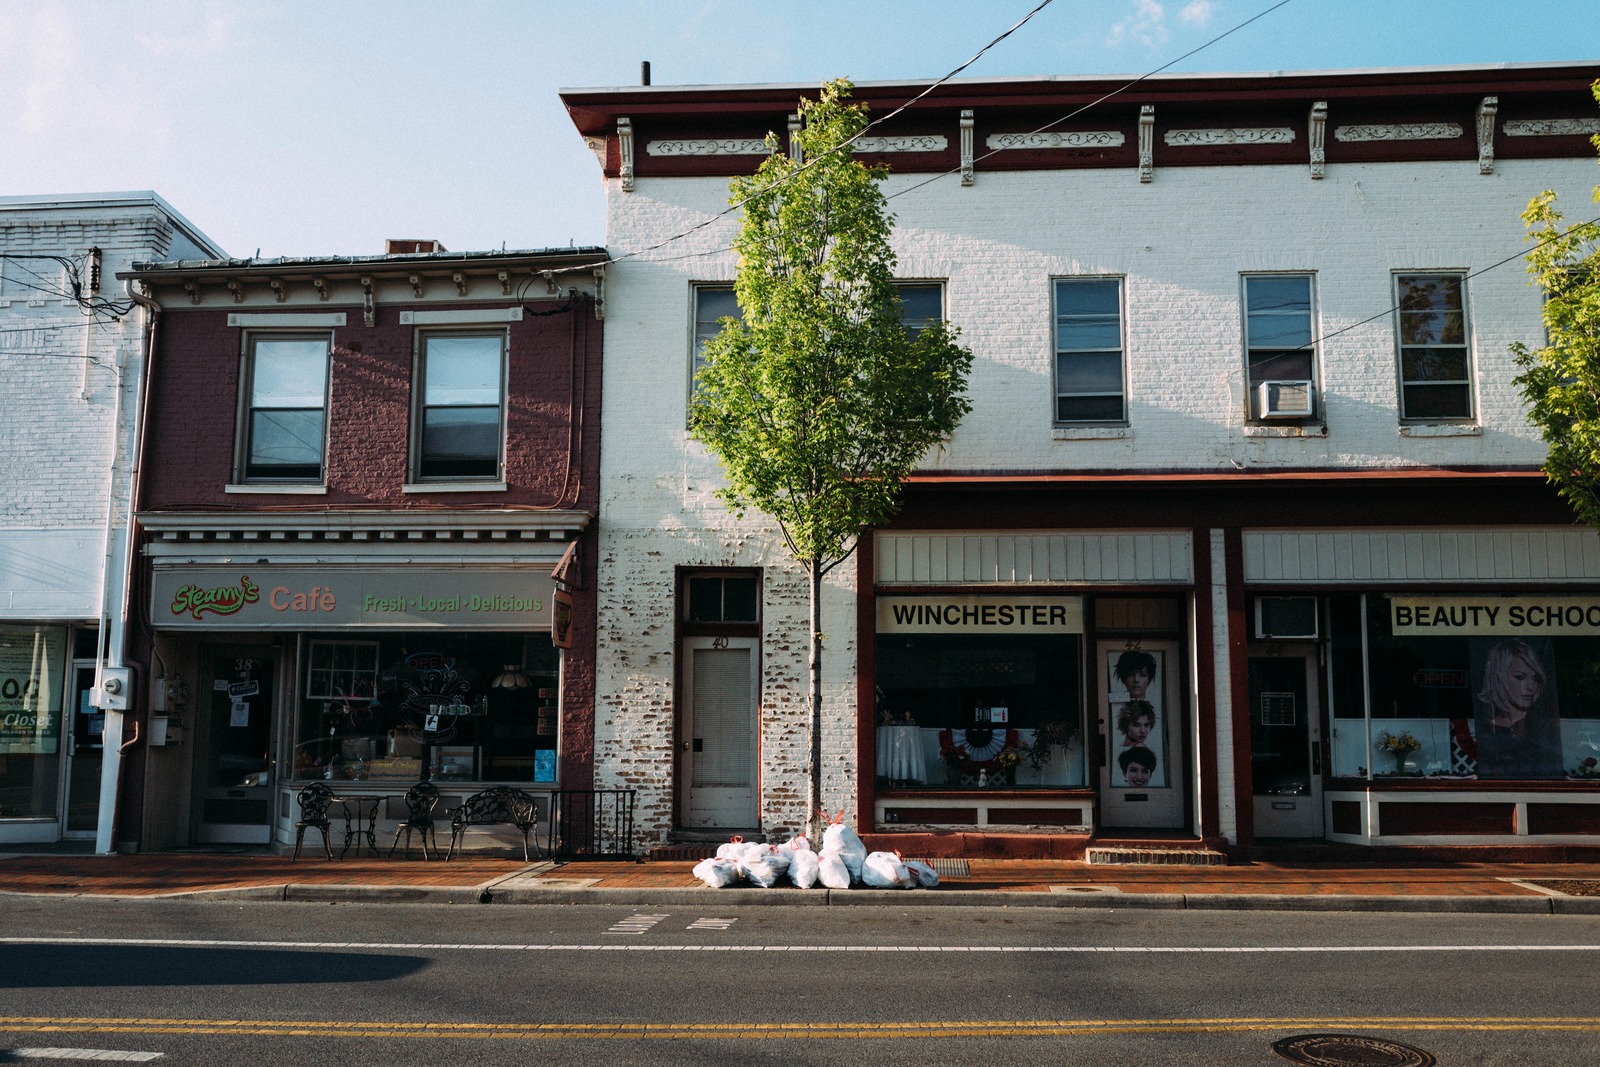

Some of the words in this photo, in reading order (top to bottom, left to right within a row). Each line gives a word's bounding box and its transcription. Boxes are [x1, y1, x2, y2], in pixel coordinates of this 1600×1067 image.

[171, 577, 259, 620] Steamy's
[364, 594, 408, 612] Fresh
[418, 595, 461, 612] Local
[470, 594, 543, 612] Delicious
[892, 604, 1067, 626] WINCHESTER
[1395, 606, 1500, 627] BEAUTY
[712, 632, 729, 649] 40
[233, 658, 253, 671] 38
[408, 656, 450, 670] OPEN
[1412, 671, 1464, 686] OPEN
[4, 713, 53, 727] Closet
